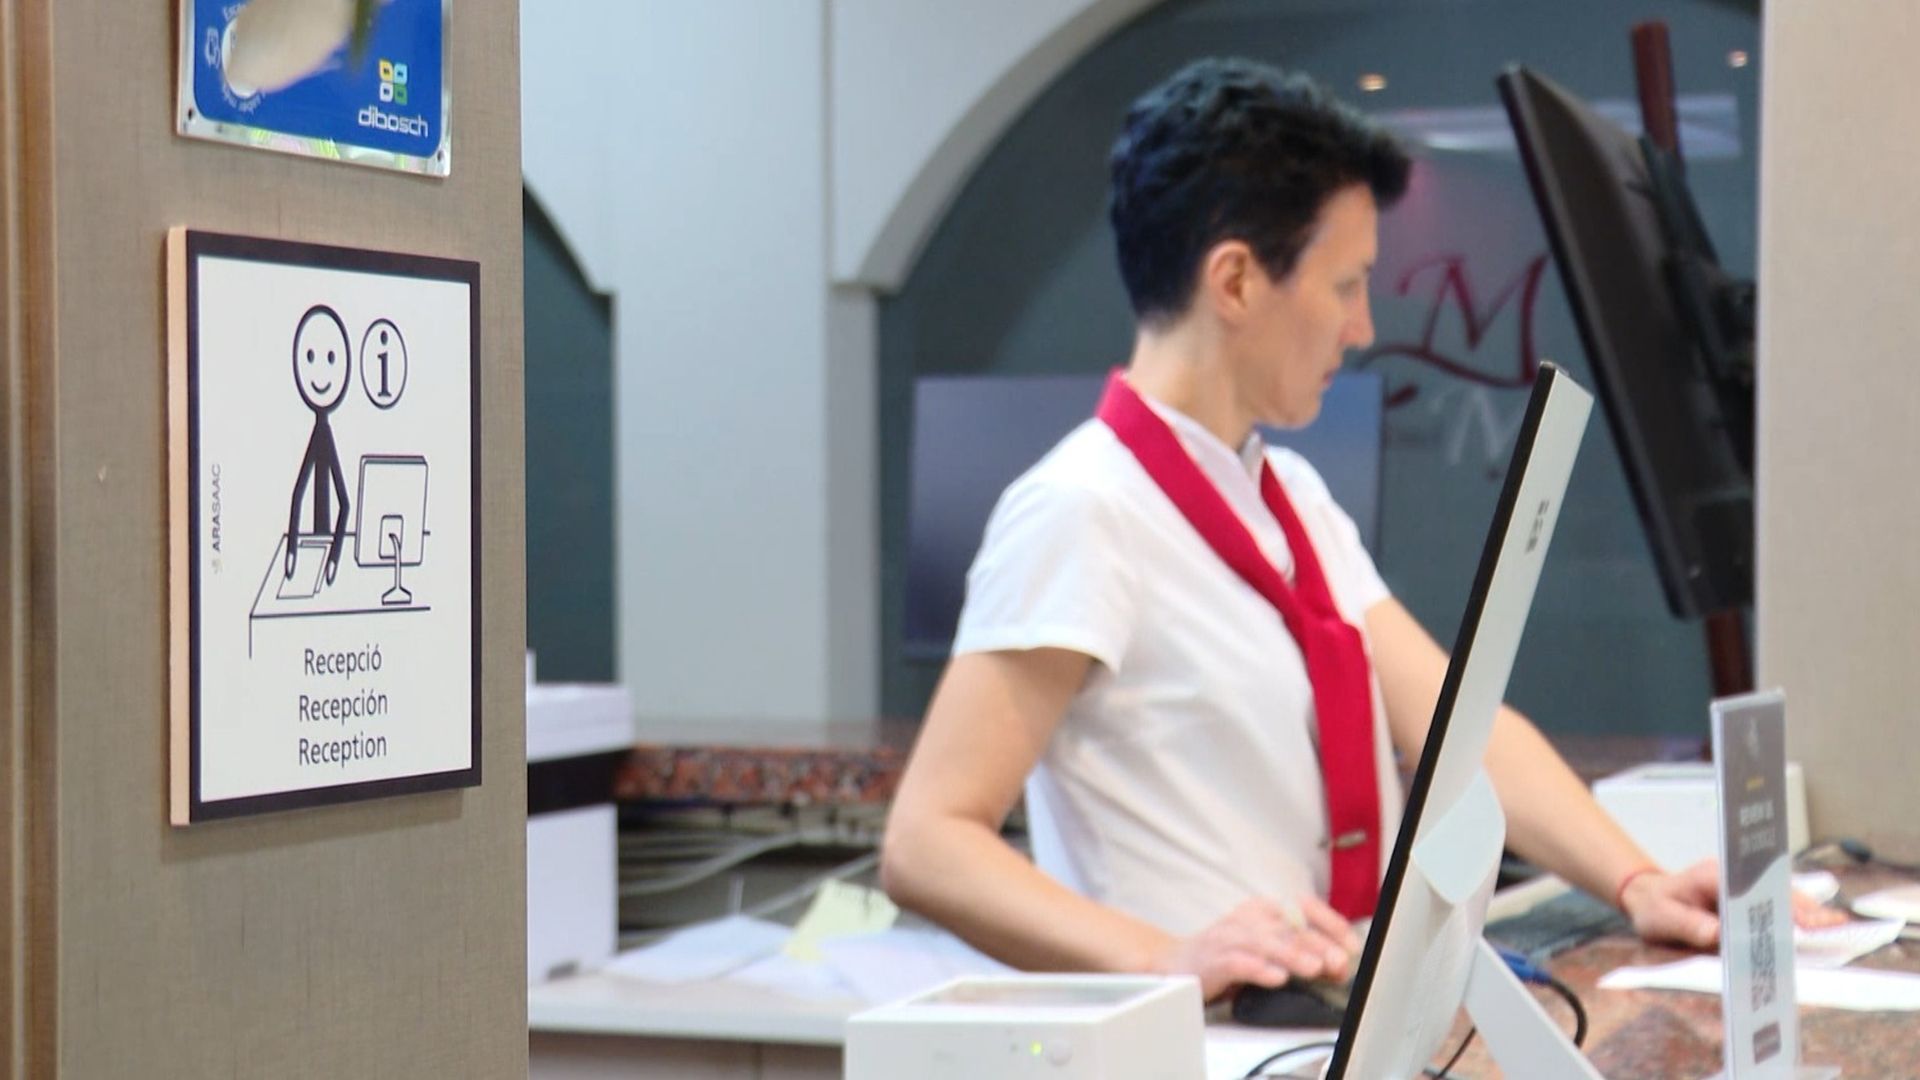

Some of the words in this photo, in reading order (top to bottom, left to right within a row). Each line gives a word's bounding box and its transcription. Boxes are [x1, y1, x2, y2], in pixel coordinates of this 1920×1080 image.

[358, 104, 429, 138] dibosch
[211, 463, 221, 552] ARASAAC
[304, 643, 382, 680] Recepció
[299, 688, 388, 726] Recepción
[299, 731, 387, 768] Reception
